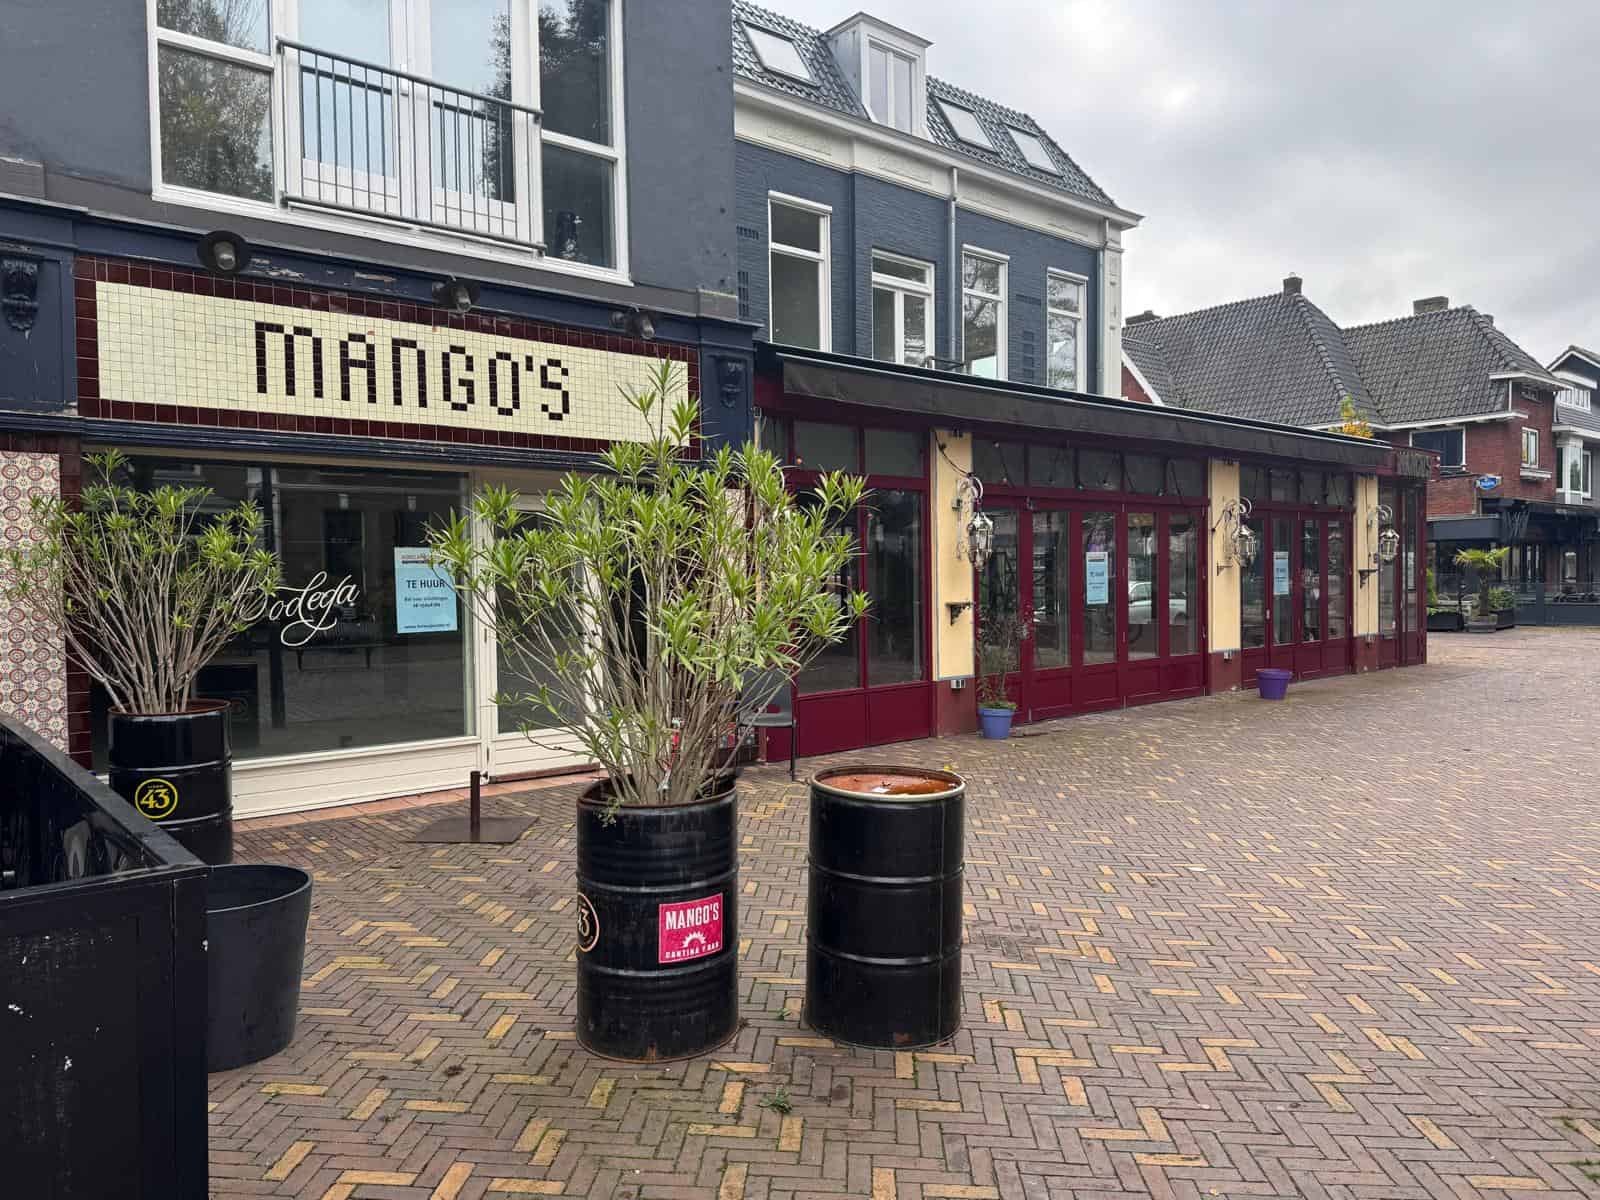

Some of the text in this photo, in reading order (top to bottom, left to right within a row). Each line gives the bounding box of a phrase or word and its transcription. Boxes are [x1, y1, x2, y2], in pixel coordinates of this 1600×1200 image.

[255, 321, 570, 421] MANGO'S
[406, 579, 445, 589] TE HUUR
[140, 788, 170, 809] 43
[665, 902, 720, 930] MANGO'S
